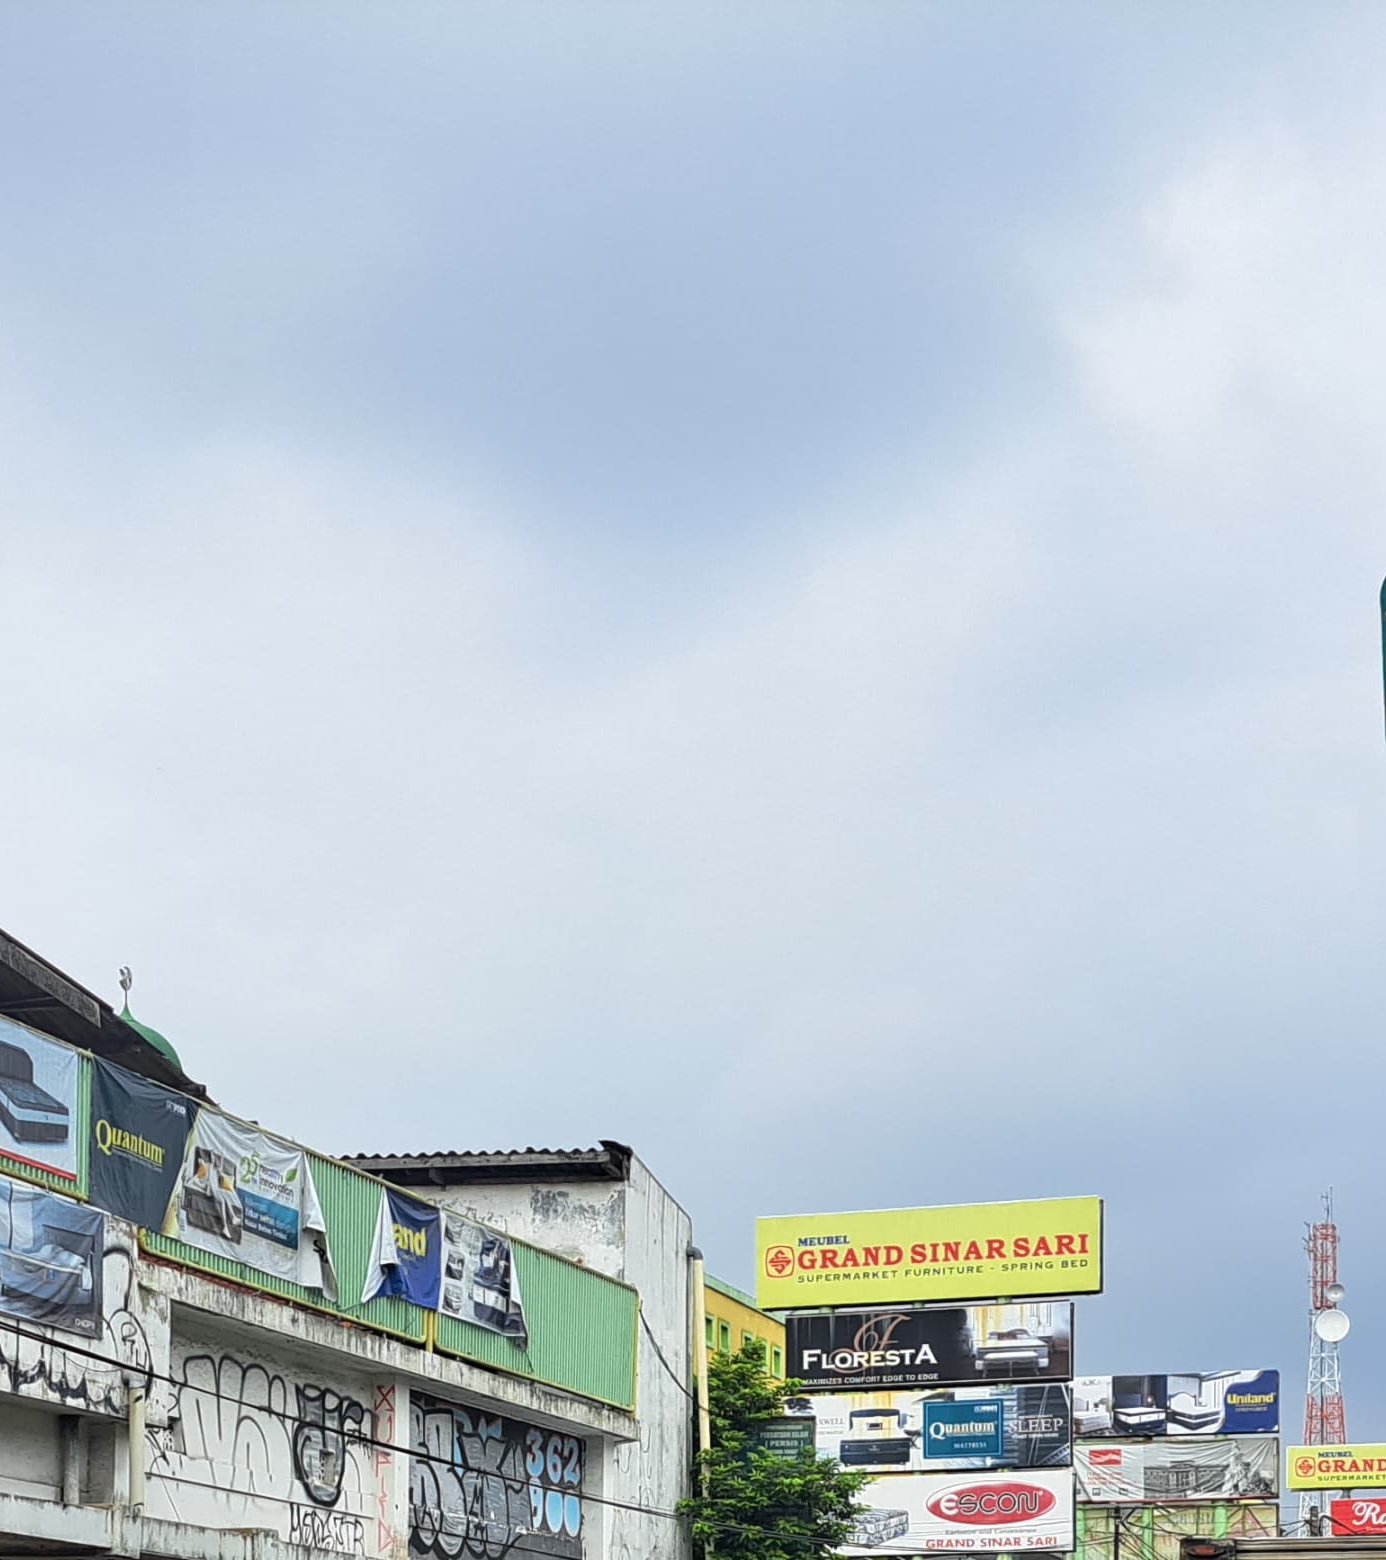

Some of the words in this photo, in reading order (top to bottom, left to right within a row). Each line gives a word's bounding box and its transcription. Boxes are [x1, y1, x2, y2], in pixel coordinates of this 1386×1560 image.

[95, 1119, 163, 1166] Quantum
[797, 1235, 850, 1247] MEUBEL
[797, 1245, 904, 1270] GRAND
[909, 1240, 1005, 1264] SINAR
[1012, 1233, 1089, 1258] SARI
[797, 1269, 898, 1283] SUPERMARKET
[904, 1265, 984, 1278] FURNITURE
[1001, 1260, 1054, 1272] SPRING
[1060, 1259, 1088, 1269] BED
[802, 1343, 938, 1371] FLORESTA
[844, 1375, 881, 1384] COMFORT
[882, 1374, 904, 1383] EDGE
[905, 1374, 916, 1382] TO
[917, 1373, 939, 1382] EDGE
[1227, 1392, 1275, 1405] Uniland
[1007, 1417, 1064, 1433] SLEEP
[525, 1428, 581, 1486] 362
[925, 1538, 975, 1550] GRAND
[980, 1537, 1022, 1548] SINAR
[1027, 1536, 1058, 1546] SARI
